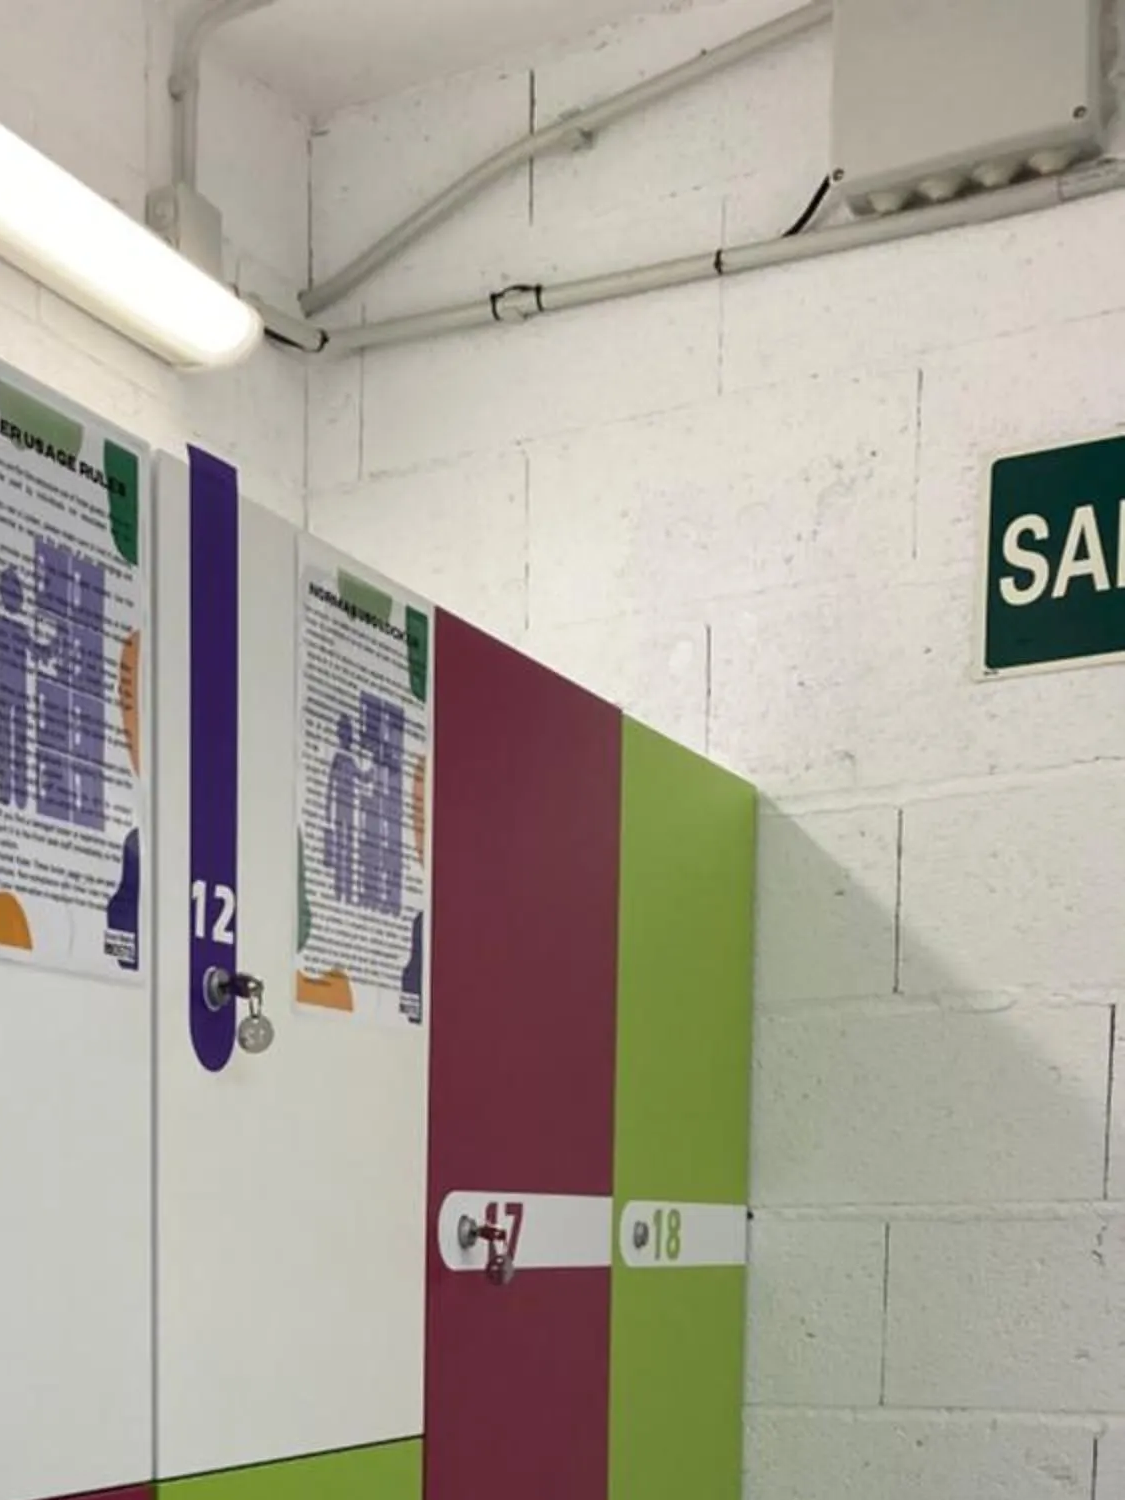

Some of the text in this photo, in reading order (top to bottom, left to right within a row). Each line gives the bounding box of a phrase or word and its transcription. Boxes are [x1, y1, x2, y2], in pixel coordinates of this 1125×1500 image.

[24, 430, 77, 473] USAGE
[999, 498, 1125, 607] SA
[192, 879, 236, 945] 12
[653, 1208, 682, 1261] 18
